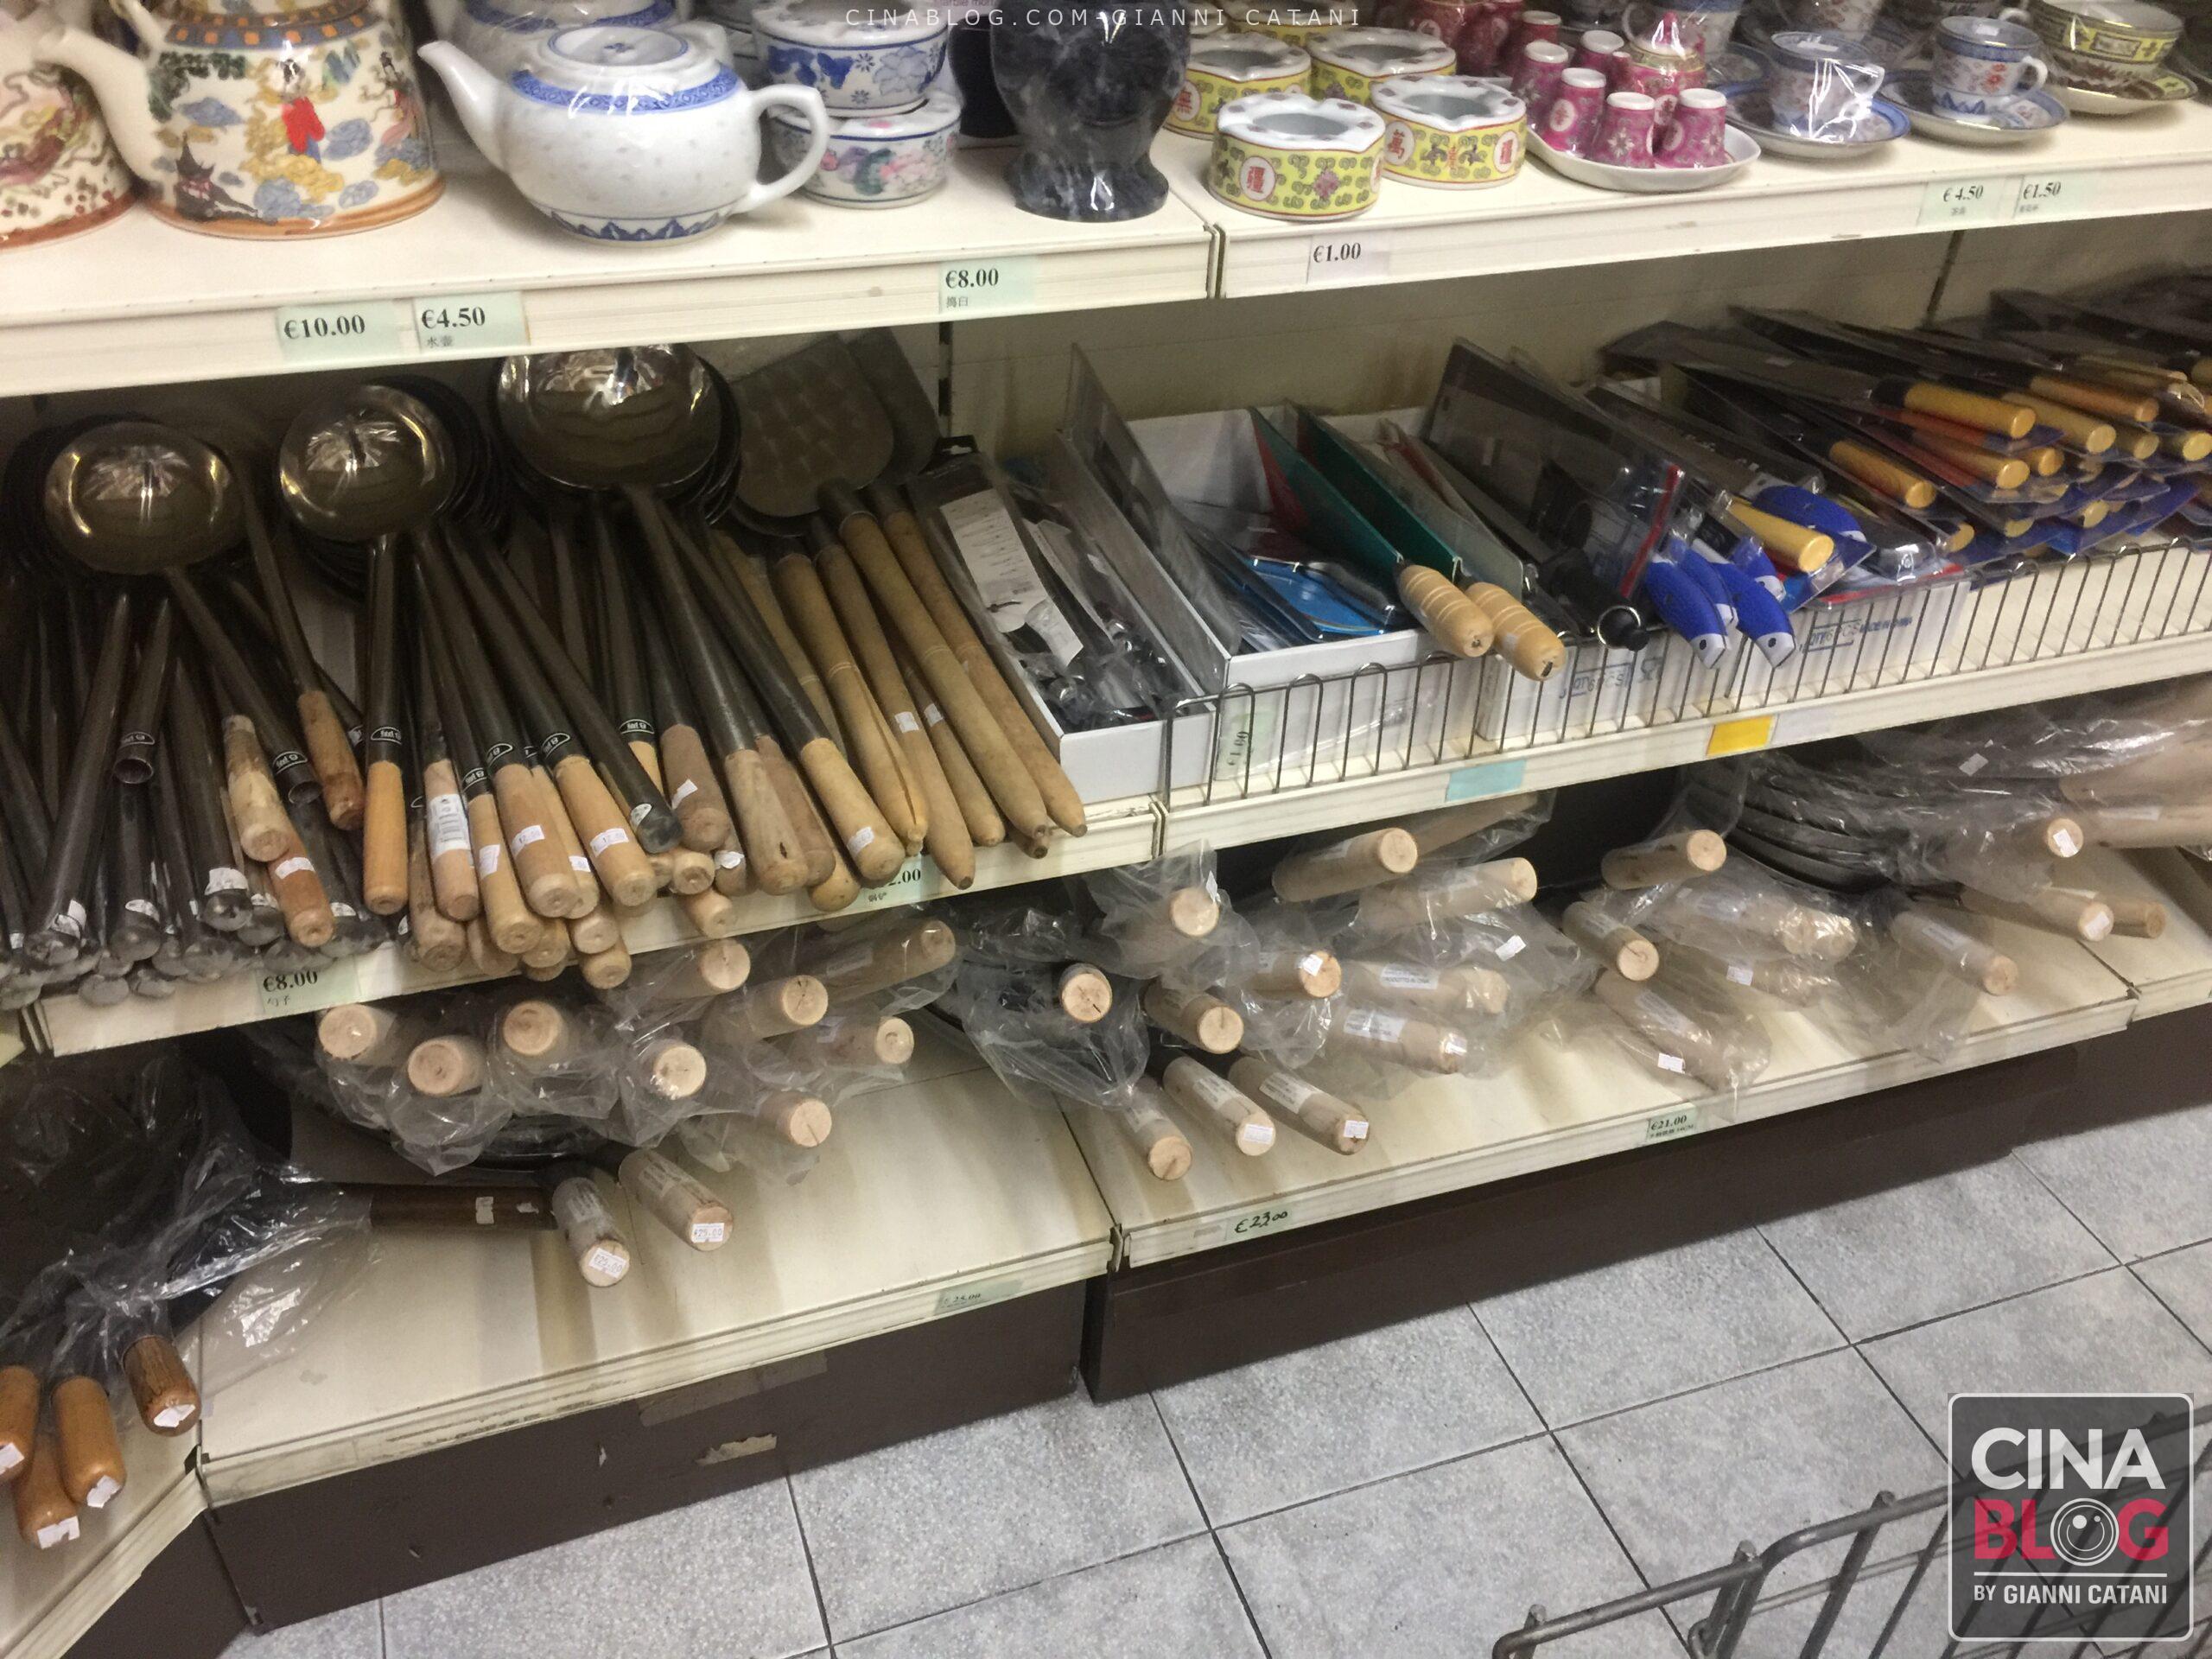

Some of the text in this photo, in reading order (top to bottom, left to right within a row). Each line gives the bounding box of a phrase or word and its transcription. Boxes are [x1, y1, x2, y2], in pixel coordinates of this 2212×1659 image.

[2023, 181, 2062, 200] €1.50
[1313, 242, 1362, 263] €1.00
[945, 268, 999, 289] €8.00
[283, 315, 365, 340] €10.00
[421, 306, 486, 329] €4.50
[263, 969, 318, 992] €8.00
[1650, 1115, 1688, 1130] €21.00
